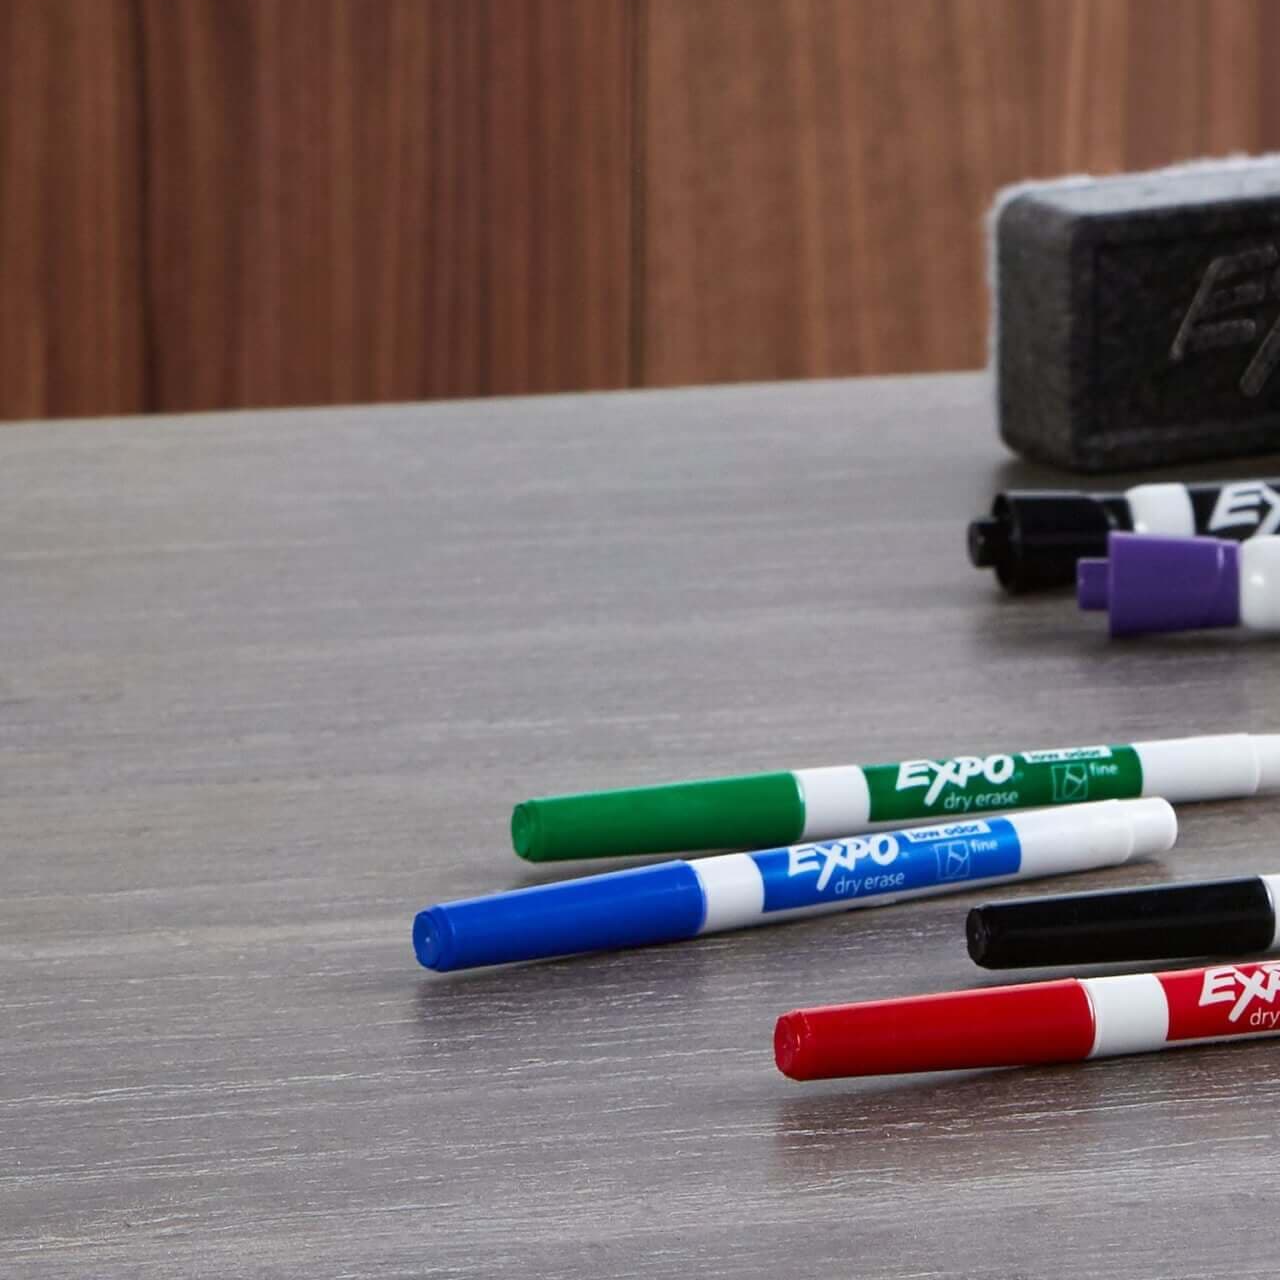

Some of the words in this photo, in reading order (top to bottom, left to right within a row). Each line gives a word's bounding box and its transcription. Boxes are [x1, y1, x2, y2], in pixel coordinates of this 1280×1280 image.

[1089, 761, 1118, 776] fine
[896, 754, 1015, 807] EXPO
[943, 792, 973, 812] dry
[975, 789, 1019, 806] erase
[970, 837, 998, 854] fine
[787, 834, 899, 891] EXPO
[834, 876, 864, 896] dry
[864, 871, 905, 890] erase
[1250, 1006, 1280, 1028] dry
